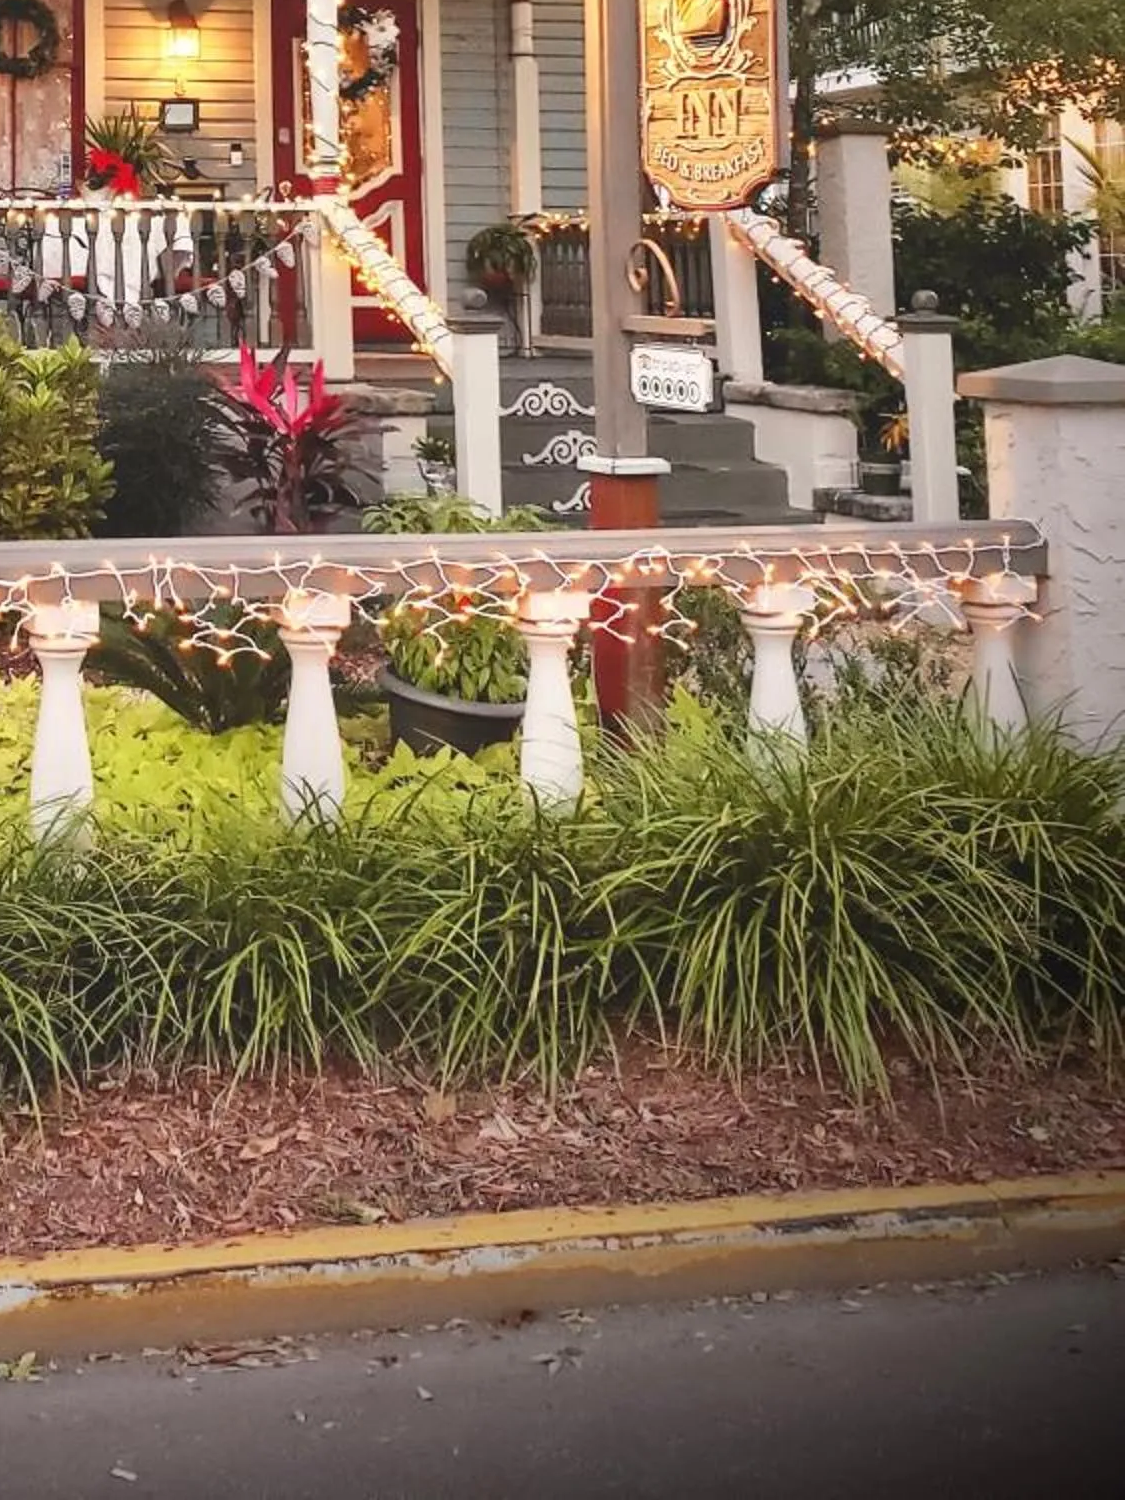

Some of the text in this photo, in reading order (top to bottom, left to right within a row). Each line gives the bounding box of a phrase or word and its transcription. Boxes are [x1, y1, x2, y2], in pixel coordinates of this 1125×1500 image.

[677, 88, 742, 138] INN
[653, 136, 766, 182] BED & BREAKFAST
